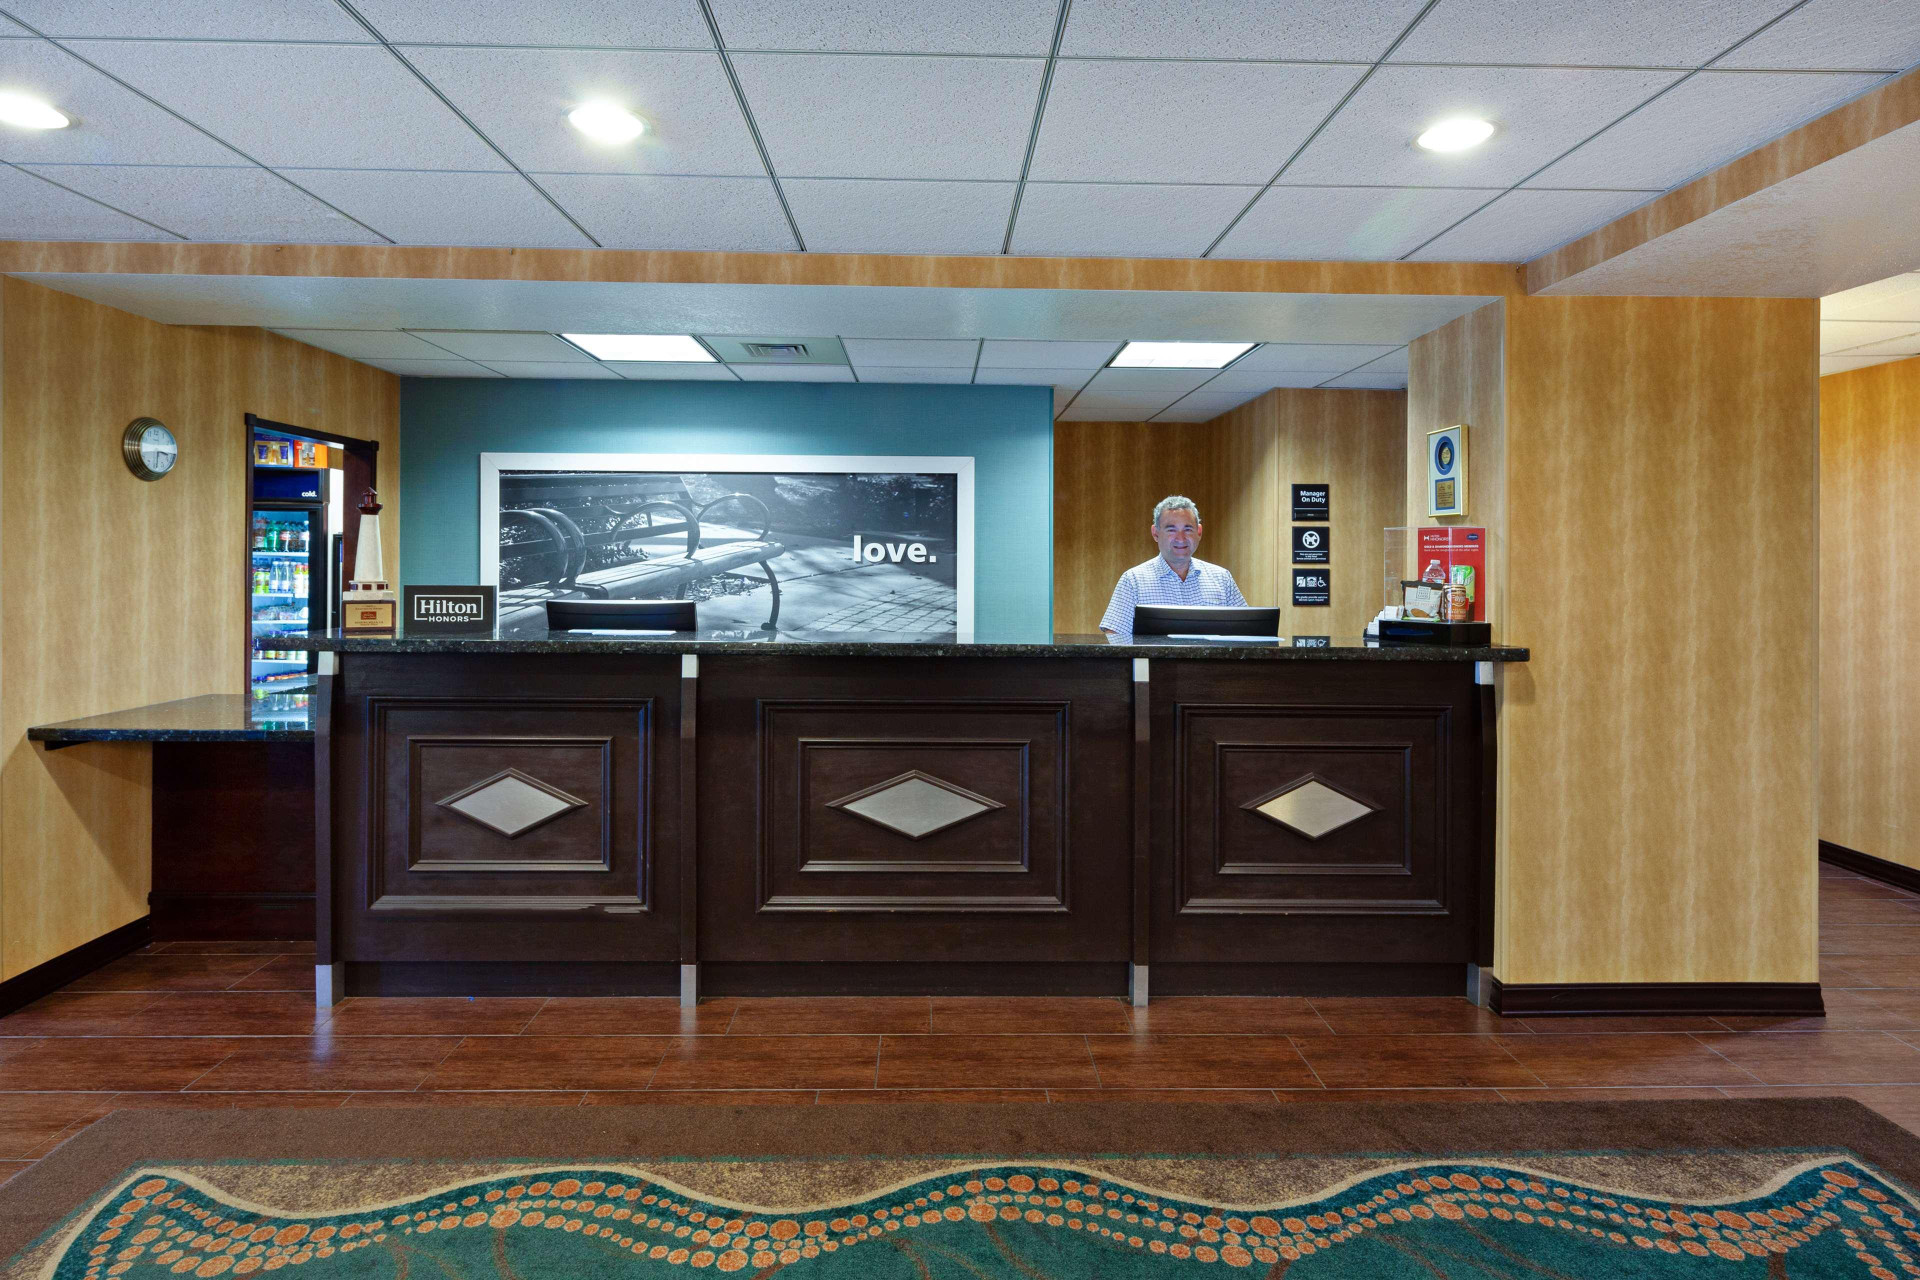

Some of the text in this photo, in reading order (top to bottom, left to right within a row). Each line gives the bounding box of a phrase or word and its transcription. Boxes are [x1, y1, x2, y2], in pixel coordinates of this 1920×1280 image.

[1311, 496, 1326, 504] Duty
[853, 535, 937, 563] love.
[420, 599, 478, 614] Hilton
